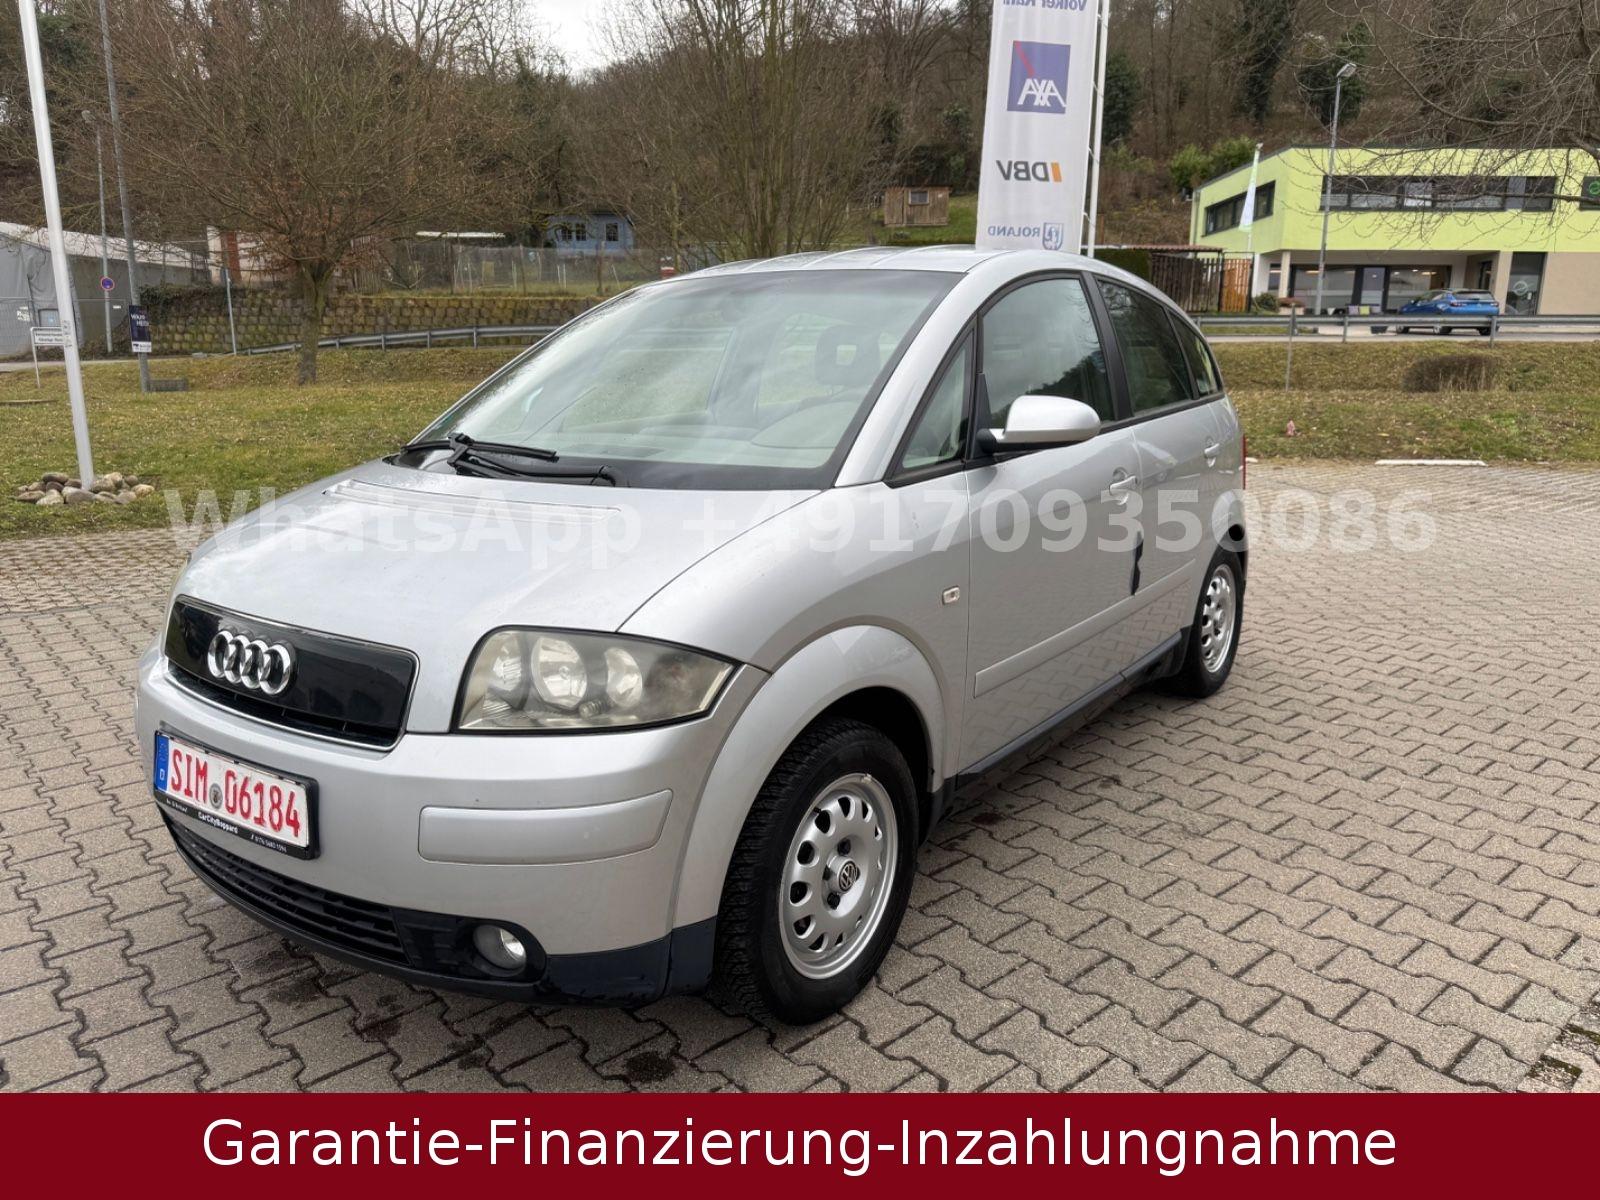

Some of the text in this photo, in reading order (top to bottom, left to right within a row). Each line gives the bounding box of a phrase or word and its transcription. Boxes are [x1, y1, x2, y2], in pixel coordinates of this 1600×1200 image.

[171, 749, 208, 804] SIM
[225, 769, 300, 838] 06184
[197, 811, 238, 835] CarCityBoppard
